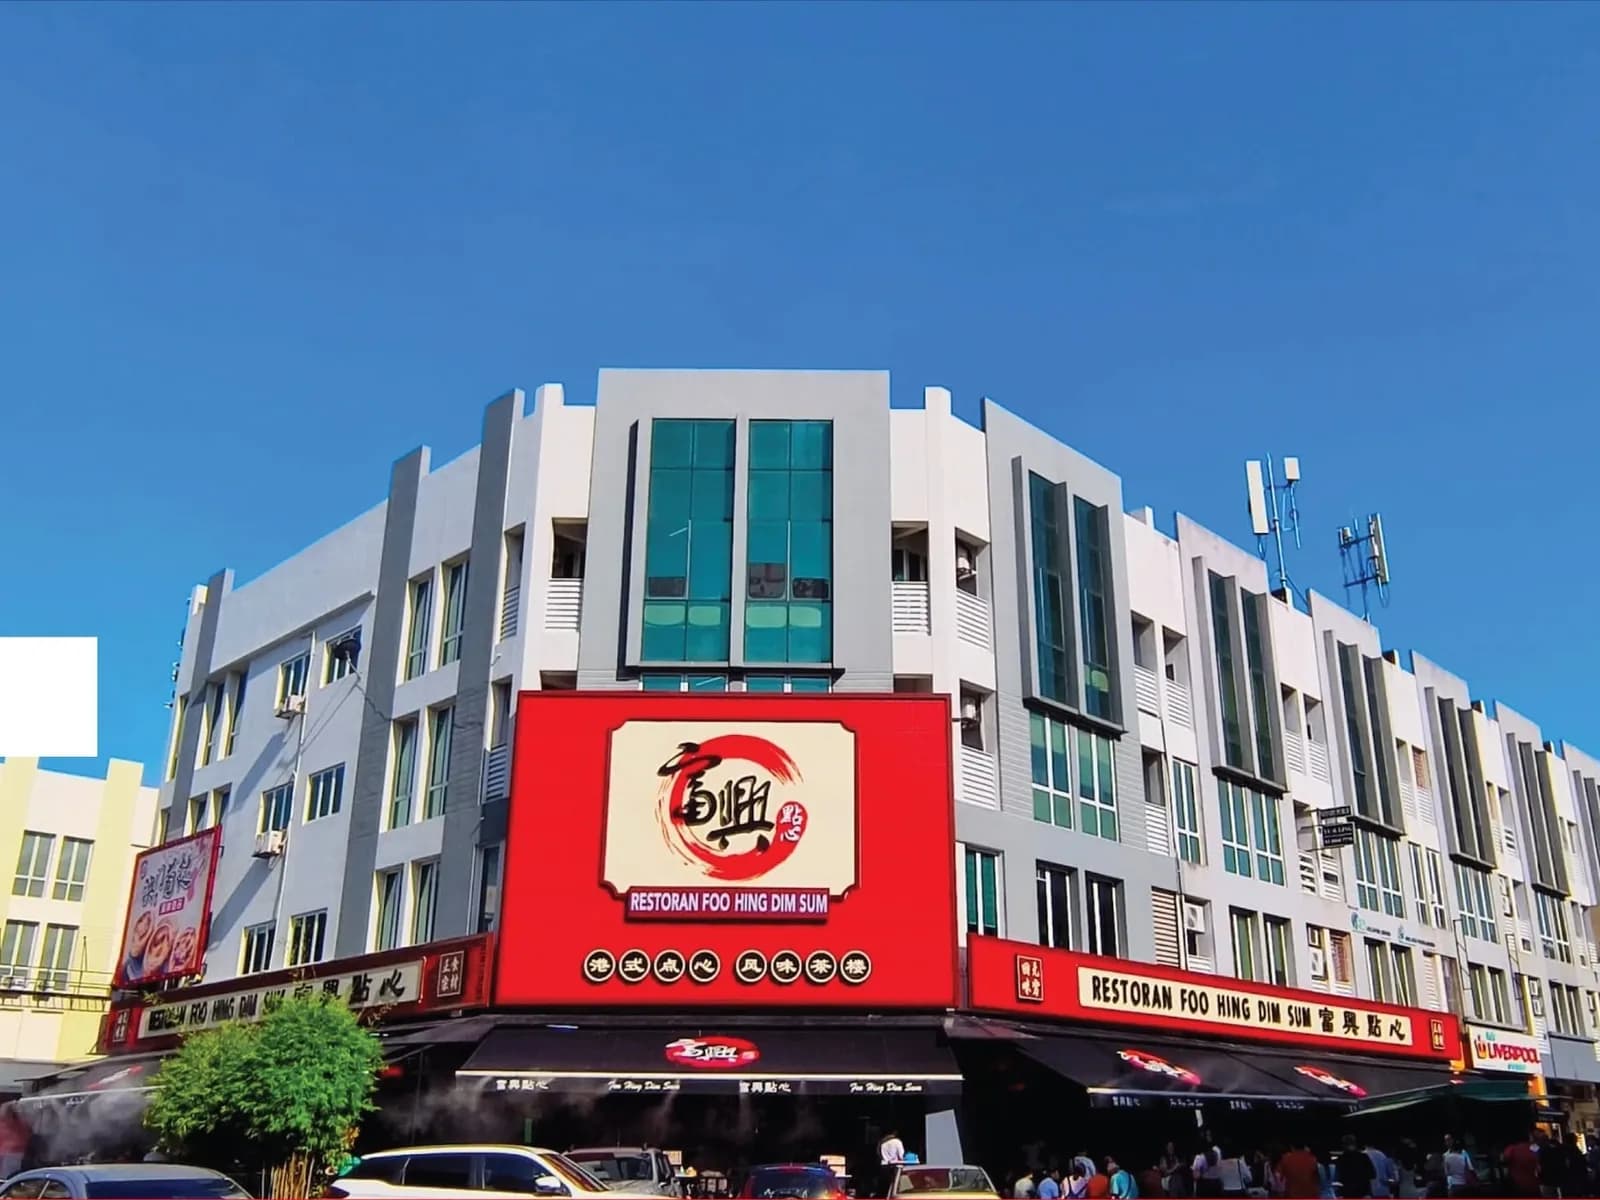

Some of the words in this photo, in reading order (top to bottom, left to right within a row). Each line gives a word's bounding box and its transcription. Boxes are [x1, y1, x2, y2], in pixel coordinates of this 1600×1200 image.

[780, 804, 802, 842] 點心
[630, 892, 699, 911] RESTORAN
[702, 893, 730, 912] FOO
[735, 893, 767, 912] HING
[771, 894, 796, 912] DIM
[800, 894, 828, 913] SUM
[587, 955, 717, 977] 港式点心
[738, 955, 869, 977] 风味茶楼
[212, 997, 235, 1021] HING
[238, 993, 258, 1018] DIM
[1092, 975, 1173, 1010] RESTORAN
[1181, 989, 1209, 1015] FOO
[1217, 994, 1251, 1021] HING
[1258, 1001, 1281, 1024] DIM
[1288, 1004, 1312, 1028] SUM
[1319, 1007, 1406, 1041] 富興點心
[1487, 1042, 1541, 1064] LIVERPOOL
